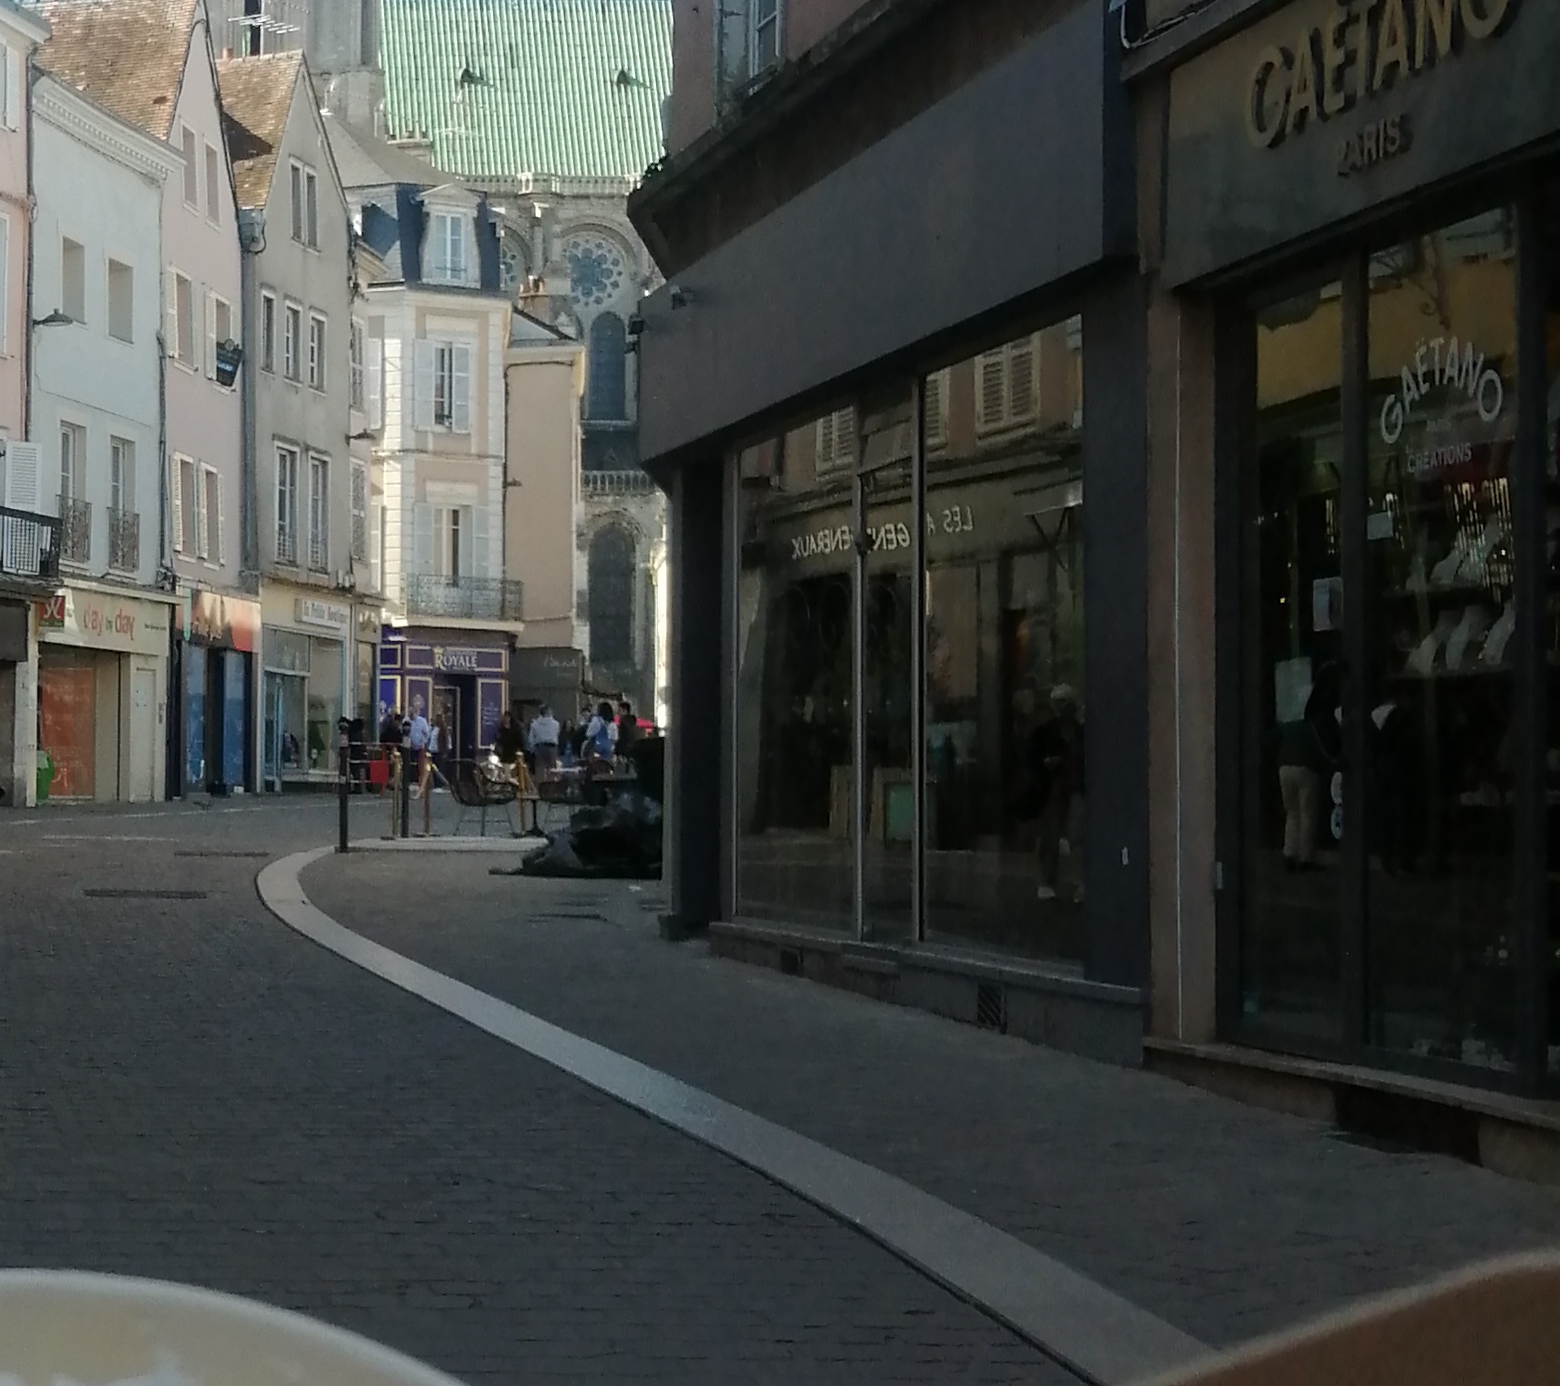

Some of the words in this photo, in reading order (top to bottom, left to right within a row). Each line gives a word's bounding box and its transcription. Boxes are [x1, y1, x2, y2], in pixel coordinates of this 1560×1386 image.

[83, 604, 104, 636] day
[115, 608, 136, 641] day
[435, 654, 478, 670] ROYALE
